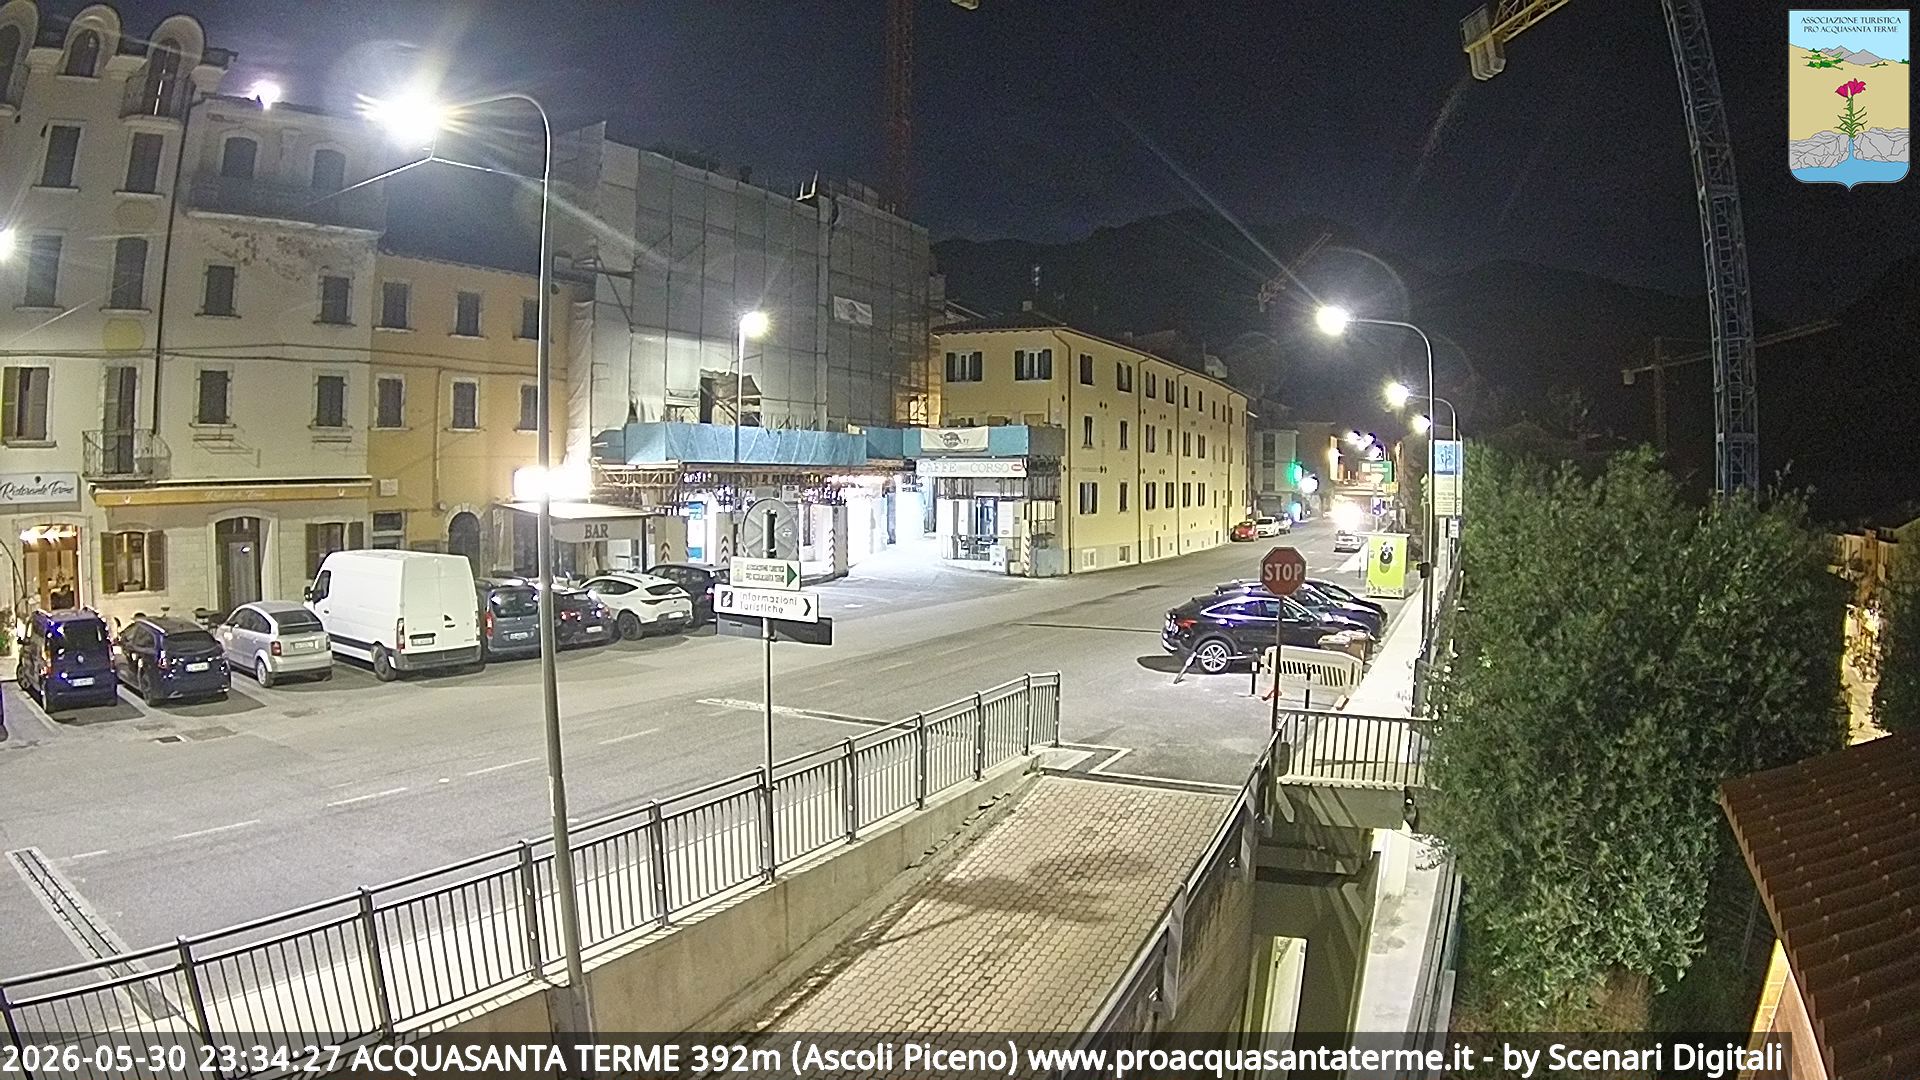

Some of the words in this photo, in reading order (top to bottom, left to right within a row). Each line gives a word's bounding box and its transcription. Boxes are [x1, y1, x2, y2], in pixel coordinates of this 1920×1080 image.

[970, 462, 1009, 472] CORSO
[584, 523, 609, 539] BAR
[1264, 563, 1303, 581] STOP
